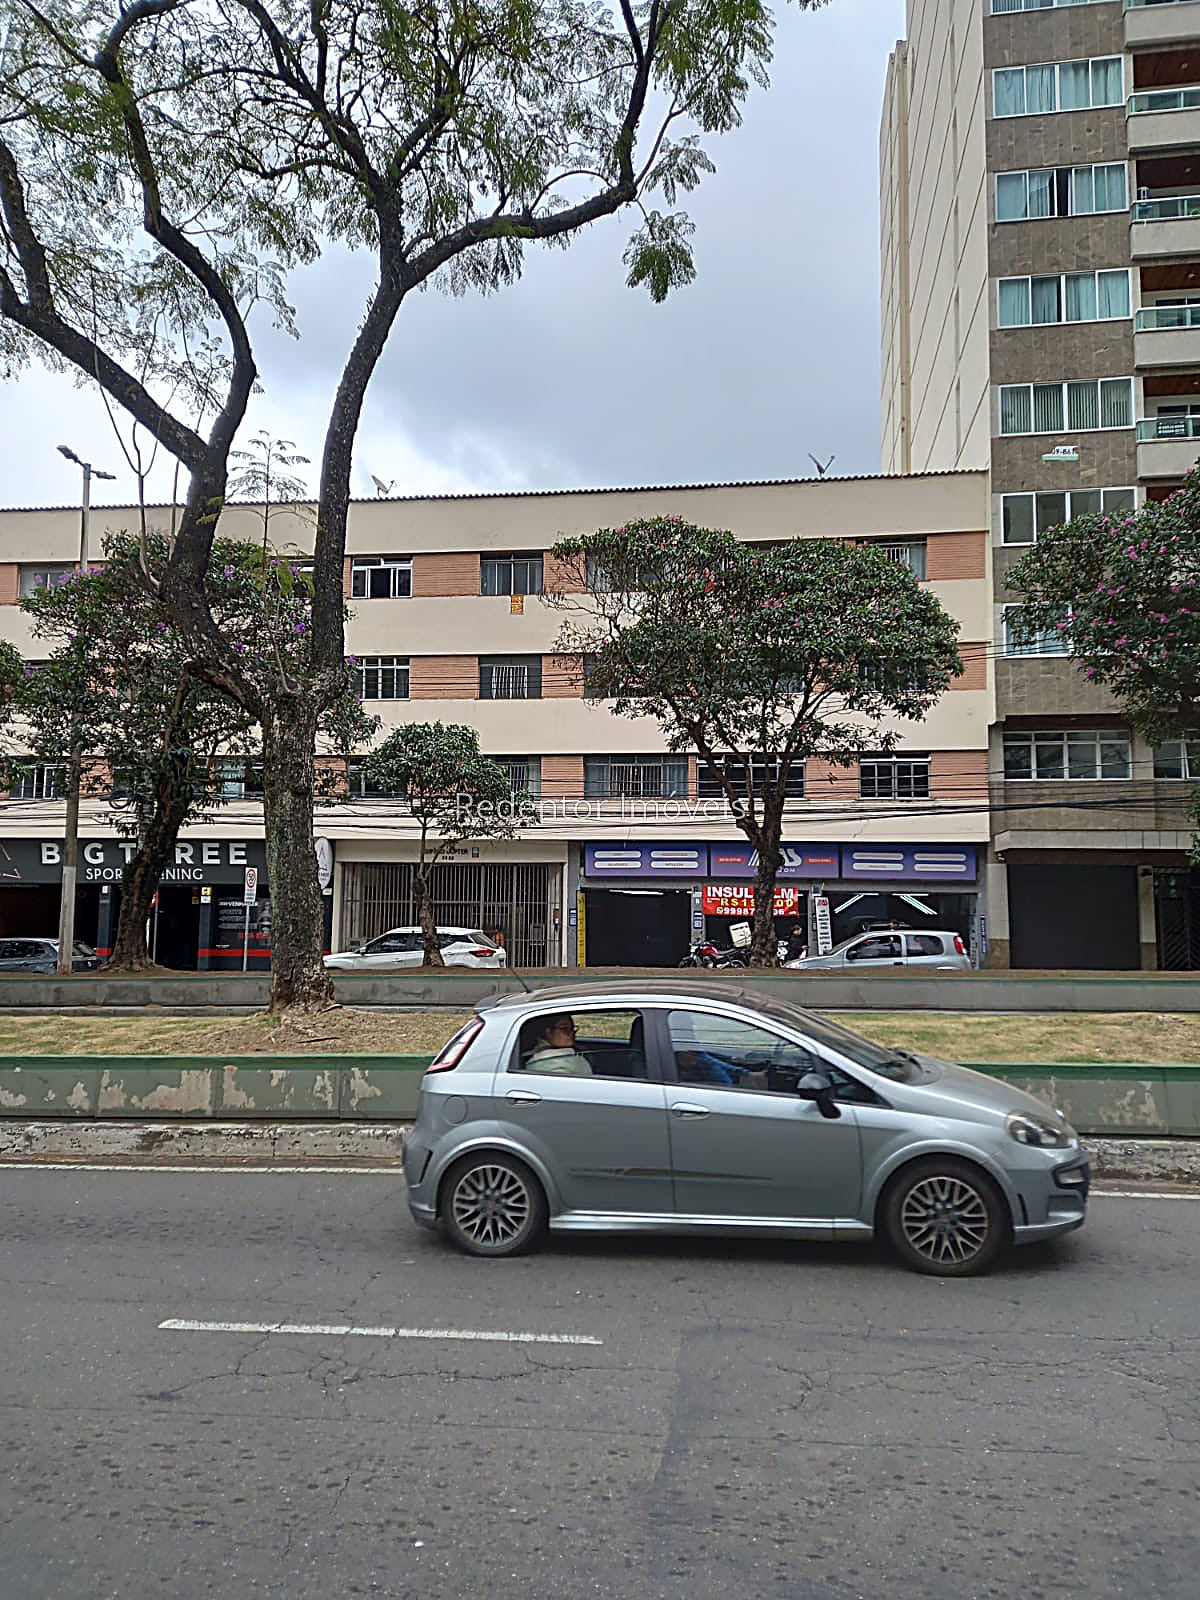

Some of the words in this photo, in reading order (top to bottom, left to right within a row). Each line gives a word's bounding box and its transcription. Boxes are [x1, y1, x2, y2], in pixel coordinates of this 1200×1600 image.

[41, 842, 105, 865] BG
[118, 842, 248, 865] TREE
[86, 867, 123, 880] SPOR
